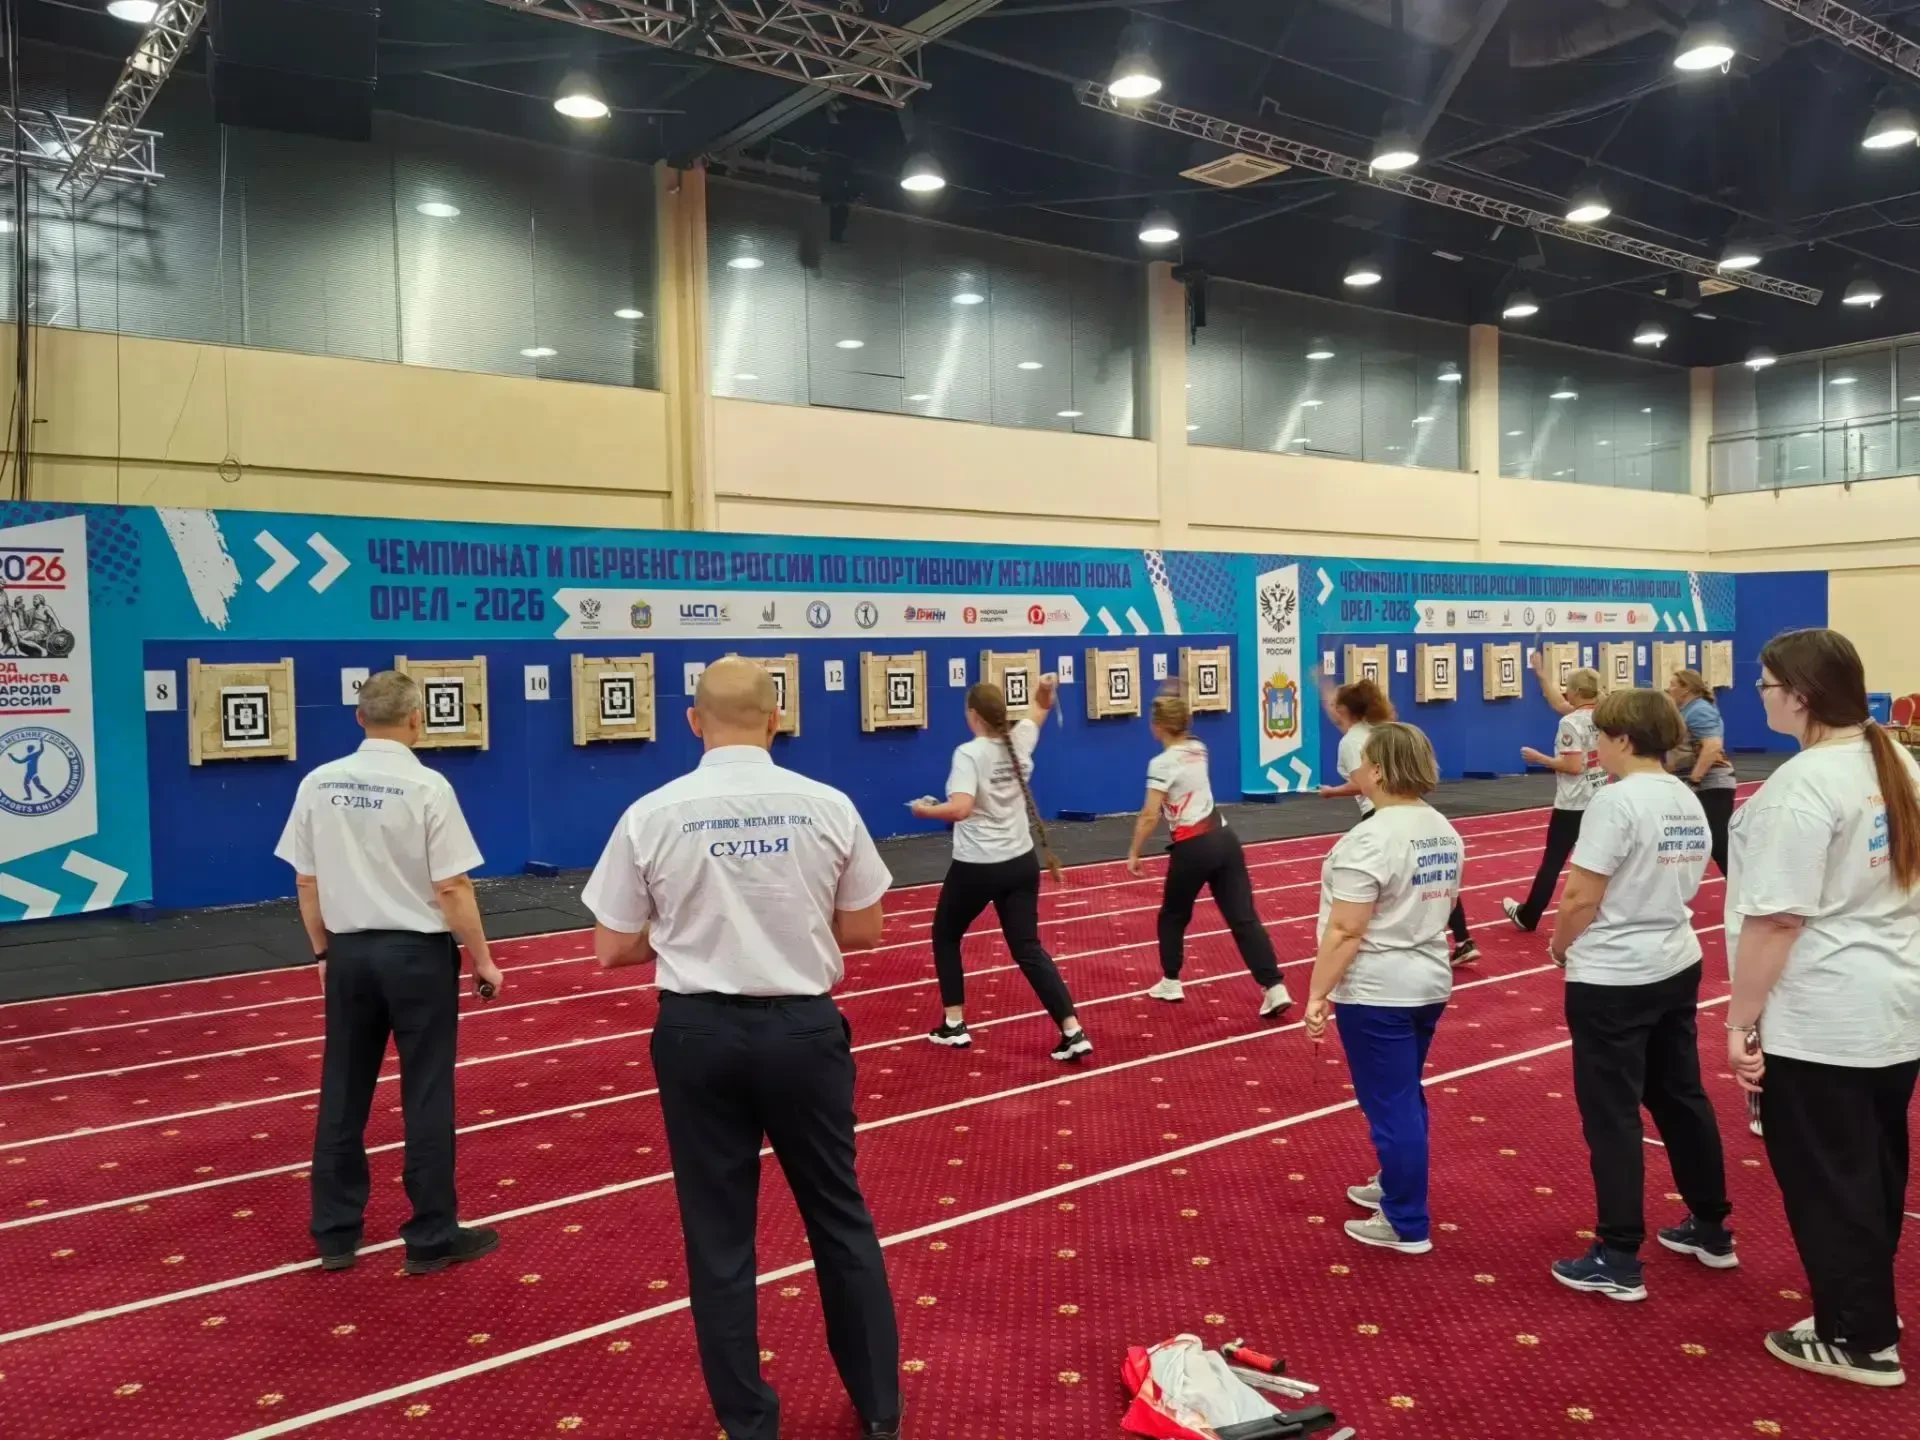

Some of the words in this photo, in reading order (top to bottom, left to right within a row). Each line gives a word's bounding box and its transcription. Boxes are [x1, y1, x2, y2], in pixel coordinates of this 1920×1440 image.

[0, 555, 66, 582] 026
[368, 538, 541, 578] ЧЕМПИОНАТ
[547, 545, 563, 578] И
[570, 546, 726, 581] ПЕРВЕНСТВО
[735, 551, 813, 583] РОССИИ
[819, 554, 847, 584] ПО
[852, 556, 992, 587] СПОРТИВНОМУ
[999, 560, 1081, 588] МЕТАНИЮ
[1085, 563, 1132, 589] НОЖА
[1340, 571, 1408, 593] ЧЕМПИОНАТ
[1412, 573, 1419, 594] И
[1421, 573, 1488, 595] ПЕРВЕНСТВО
[1490, 574, 1527, 595] РОССИИ
[1529, 576, 1542, 596] ПО
[1544, 577, 1610, 597] СПОРТИВНОМУ
[1612, 578, 1655, 598] МЕТАНИЮ
[1656, 580, 1682, 598] НОЖА
[370, 585, 449, 621] ОРЕЛ
[474, 588, 545, 621] 2026
[1341, 600, 1373, 621] ОРЕЛ
[1383, 600, 1411, 621] 2026
[0, 662, 18, 673] ОД
[952, 668, 964, 679] 13
[1061, 665, 1072, 676] 14
[1157, 662, 1166, 673] 15
[0, 673, 69, 686] ДИНСТВА
[529, 676, 547, 691] 10
[829, 670, 842, 683] 12
[0, 684, 62, 696] АРОДОВ
[156, 684, 168, 700] 8
[0, 696, 52, 707] ОССИИ
[331, 794, 384, 809] СУДЬЯ
[682, 818, 740, 833] СПОРТИВНОЕ
[744, 816, 786, 828] МЕТАНИЕ
[788, 815, 813, 826] НОЖА
[709, 837, 789, 858] СУДЬЯ
